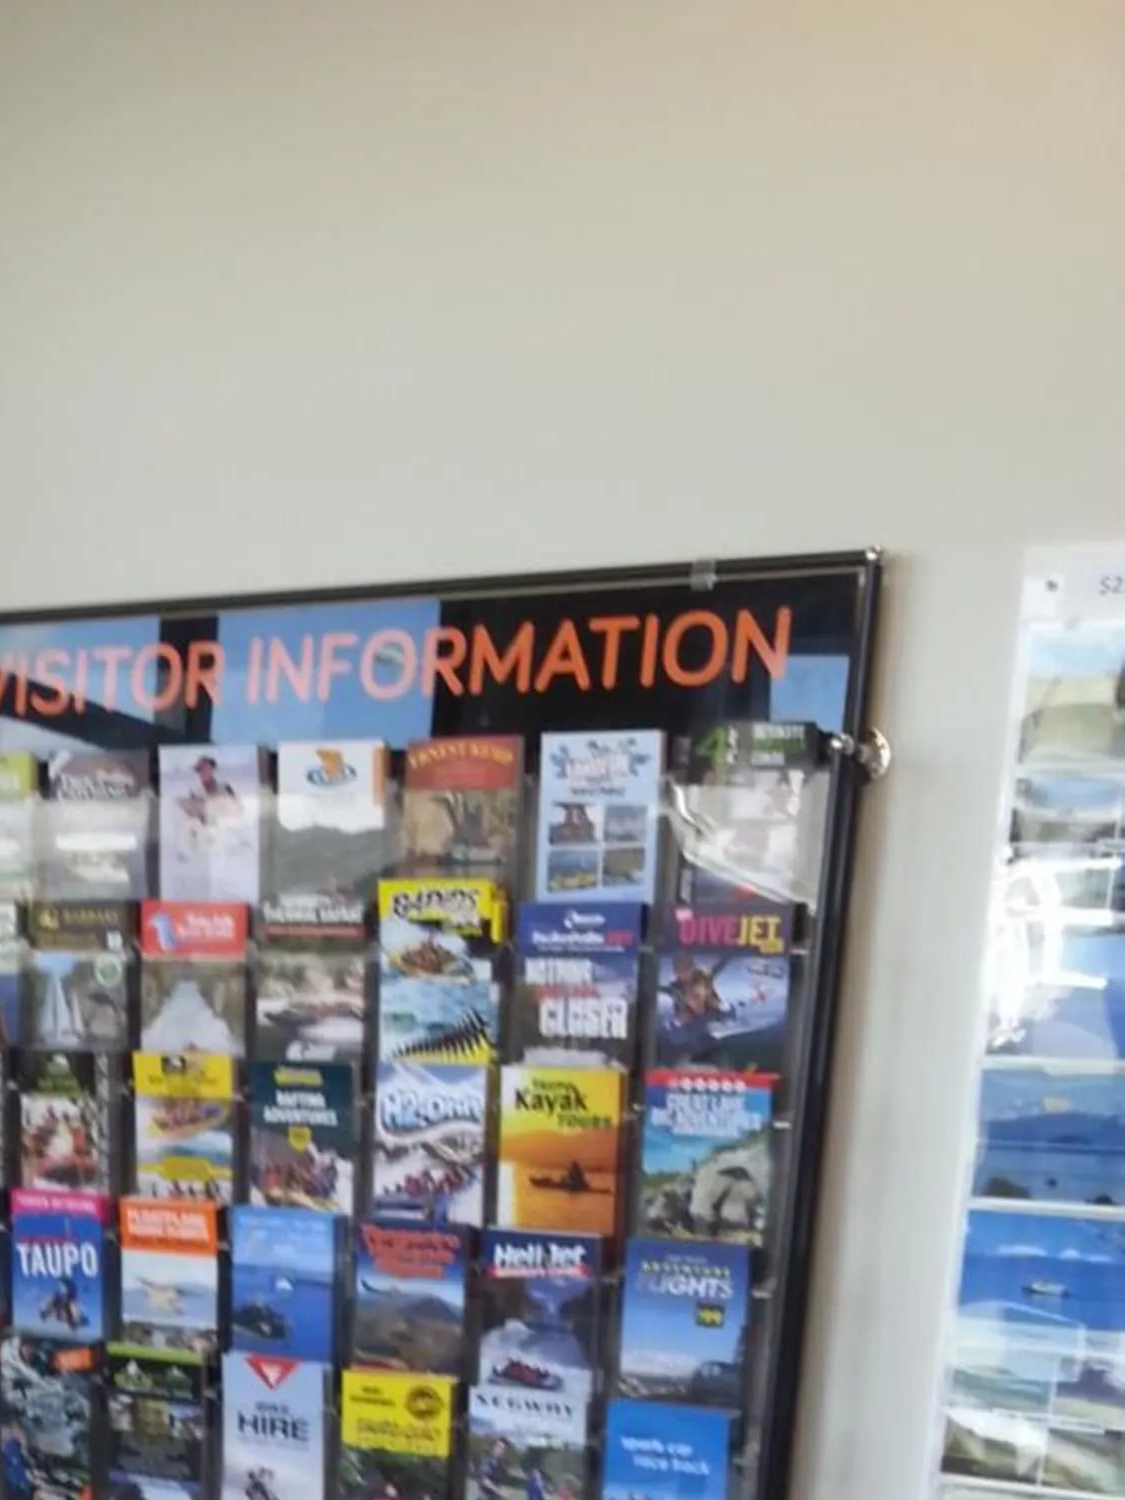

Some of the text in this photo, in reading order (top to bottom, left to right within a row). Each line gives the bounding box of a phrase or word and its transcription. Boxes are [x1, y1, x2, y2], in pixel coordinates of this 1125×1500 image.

[247, 606, 793, 703] INFORMATION
[515, 1085, 587, 1114] Kayak
[16, 1242, 98, 1279] TAUPO
[237, 1412, 310, 1442] HIRE
